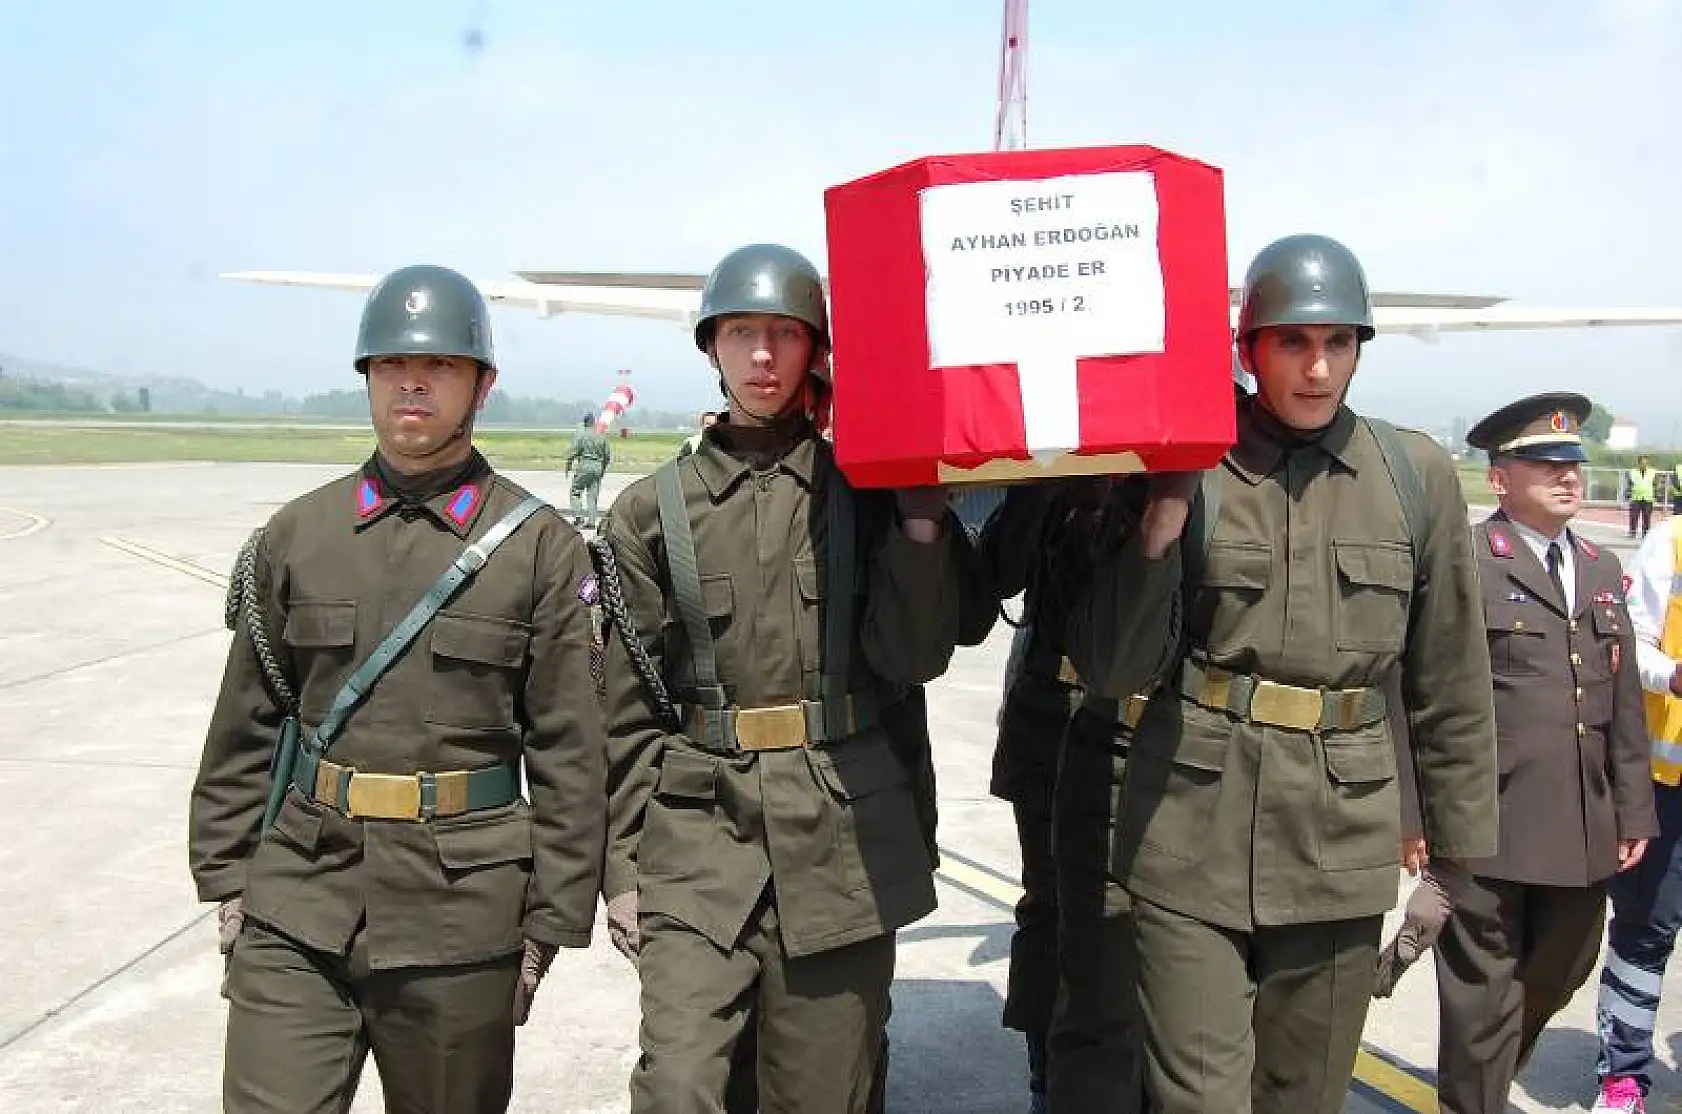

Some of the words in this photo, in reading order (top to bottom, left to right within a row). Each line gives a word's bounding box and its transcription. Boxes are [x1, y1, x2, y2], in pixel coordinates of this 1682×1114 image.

[1010, 194, 1074, 216] ŞEHİT
[951, 232, 1026, 251] AYHAN
[1034, 223, 1140, 246] ERDOĞAN
[991, 263, 1069, 282] PİYADE
[1078, 260, 1106, 276] ER
[1004, 299, 1054, 316] 1995
[1073, 296, 1085, 312] 2
